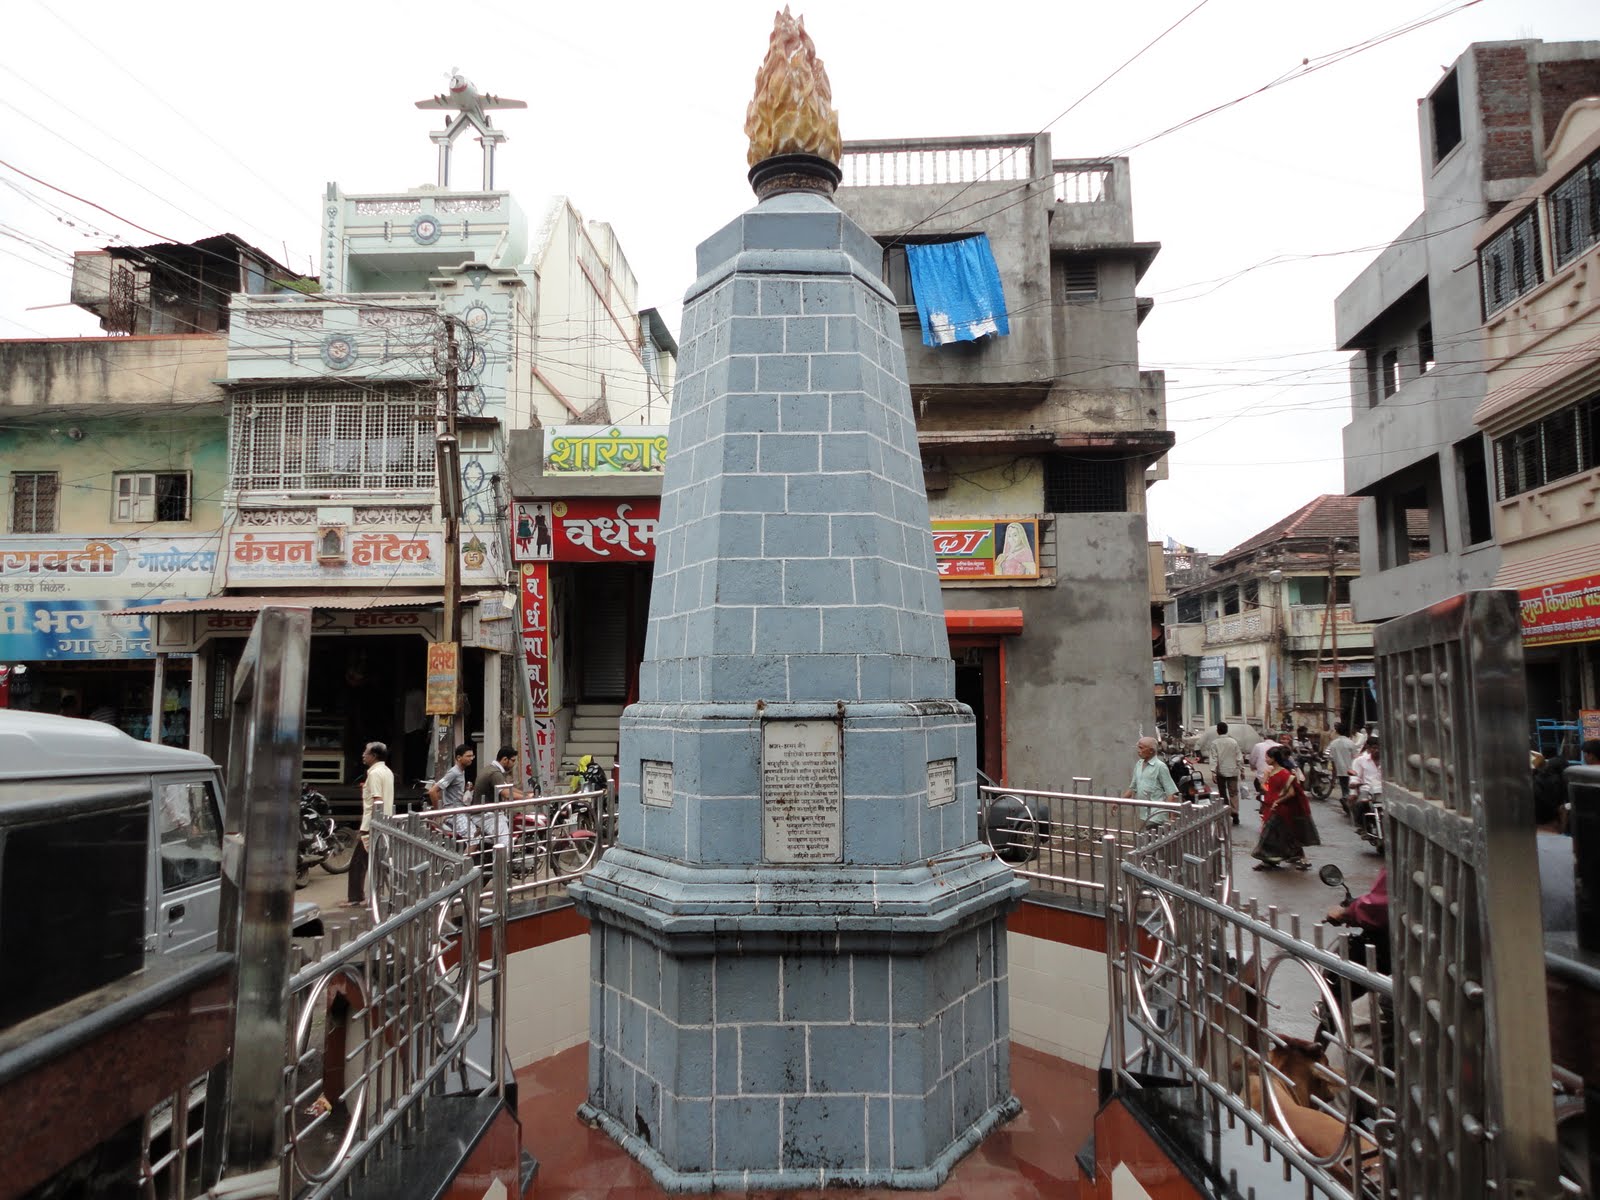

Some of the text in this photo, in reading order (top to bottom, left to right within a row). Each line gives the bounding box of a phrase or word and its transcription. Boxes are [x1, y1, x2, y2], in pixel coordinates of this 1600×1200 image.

[0, 542, 117, 573] गवती
[235, 534, 431, 565] कंचन हॉटेल
